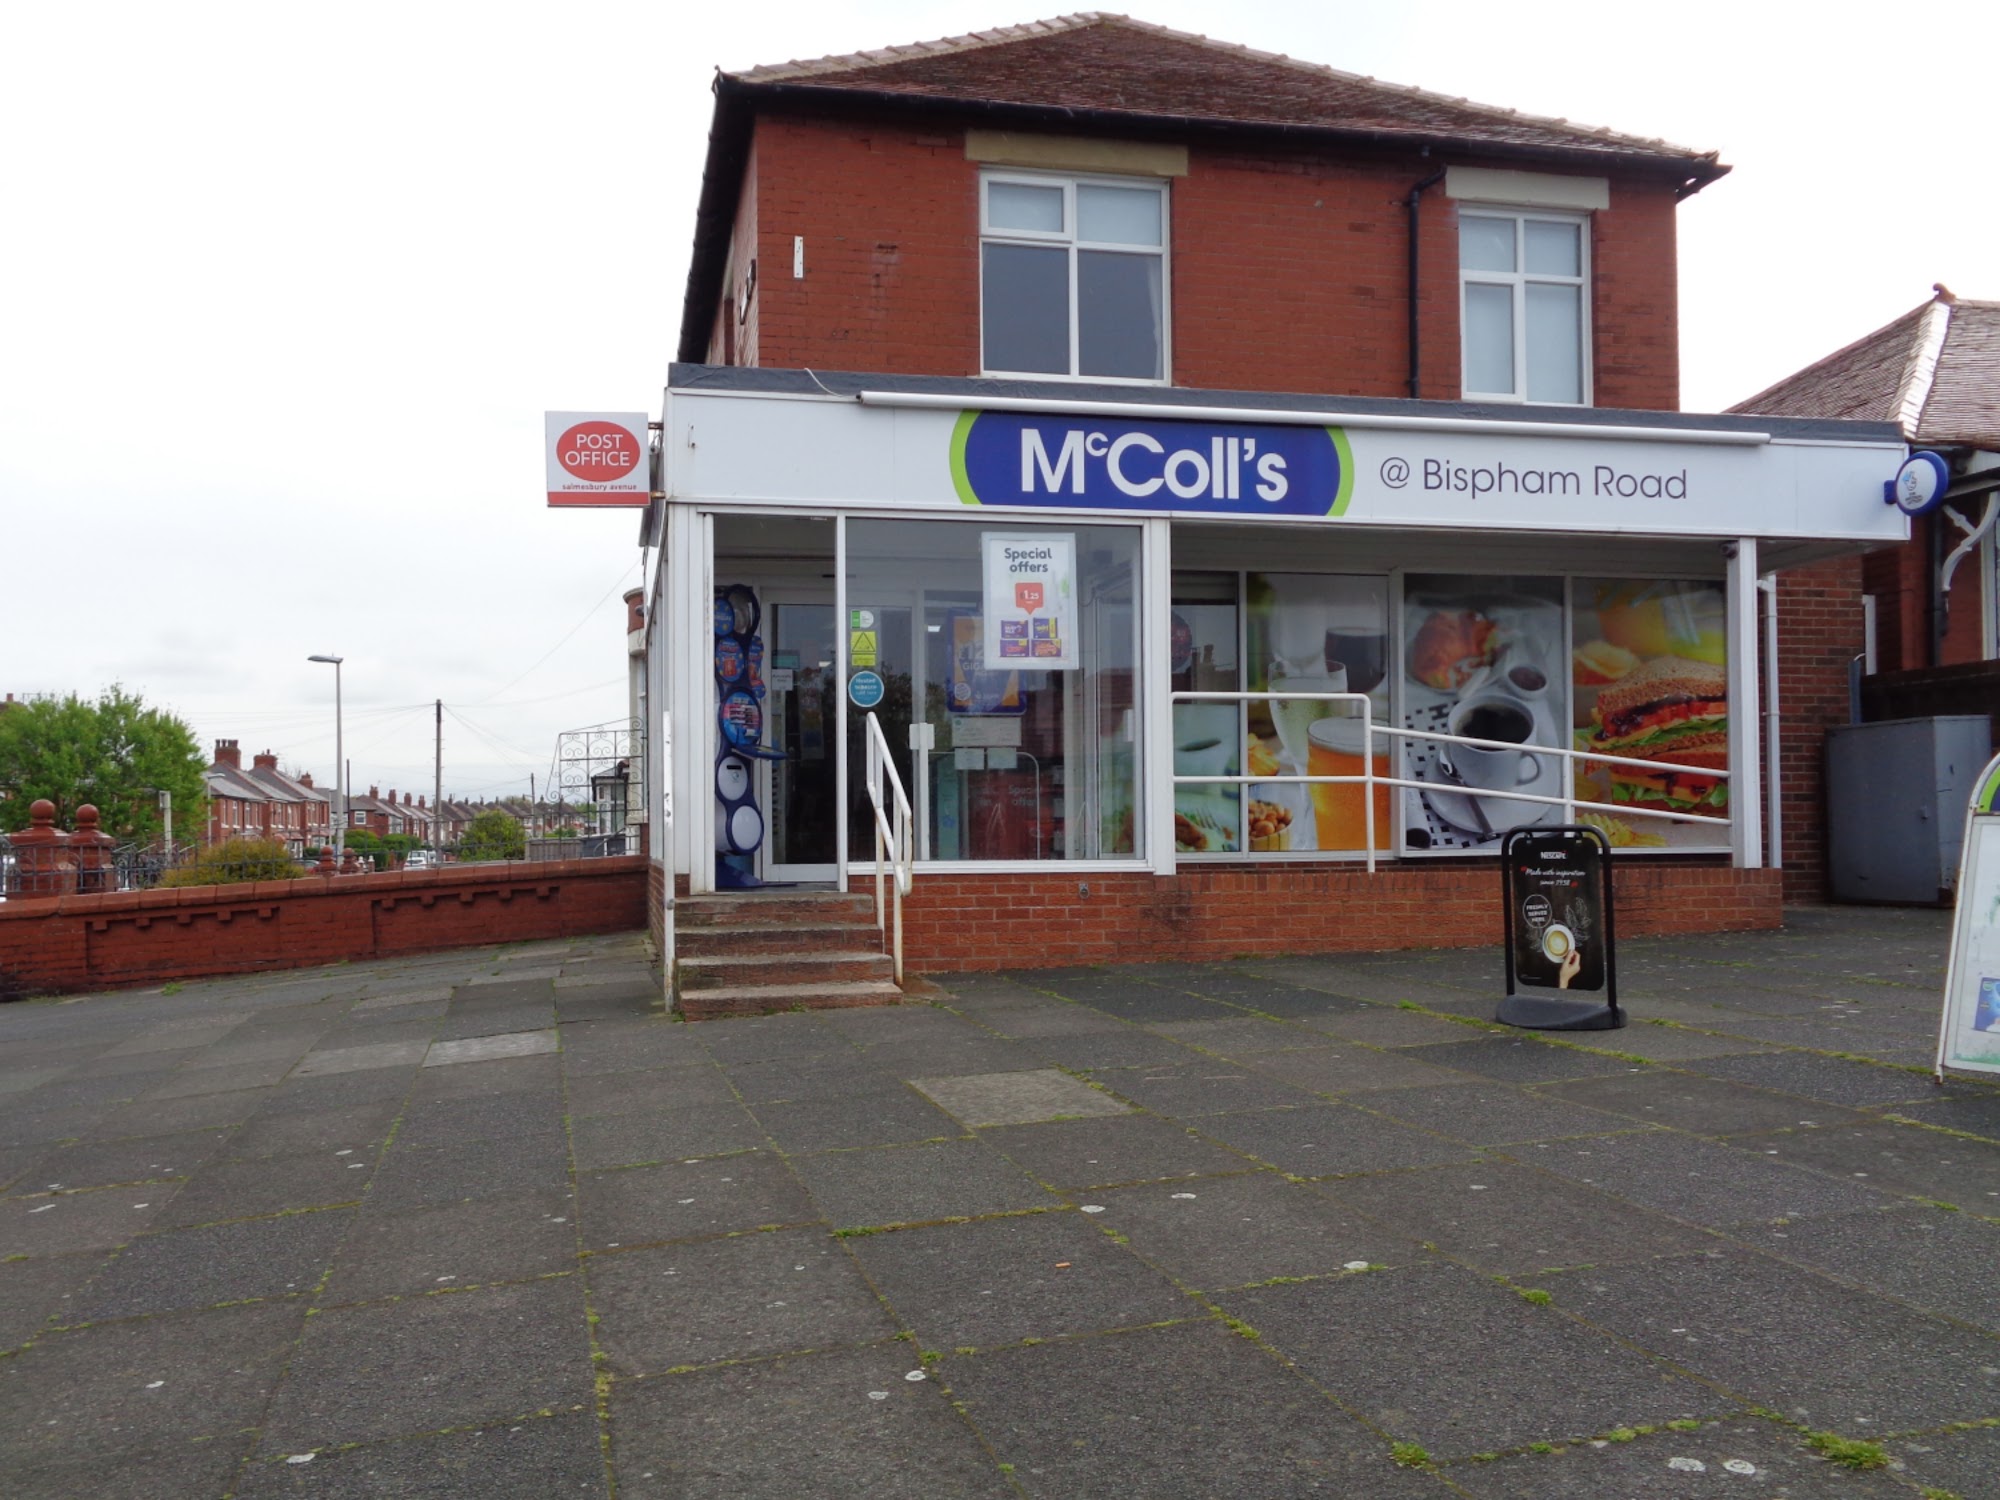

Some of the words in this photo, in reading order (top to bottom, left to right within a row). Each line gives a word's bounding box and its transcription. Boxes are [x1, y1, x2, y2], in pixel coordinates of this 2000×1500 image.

[577, 434, 623, 449] POST
[565, 451, 630, 466] OFFICE
[1020, 428, 1289, 502] McColl's
[1379, 457, 1410, 489] @
[1423, 458, 1580, 500] Bispham
[1594, 465, 1687, 500] Road
[1004, 547, 1052, 562] Special
[1009, 561, 1048, 573] offers
